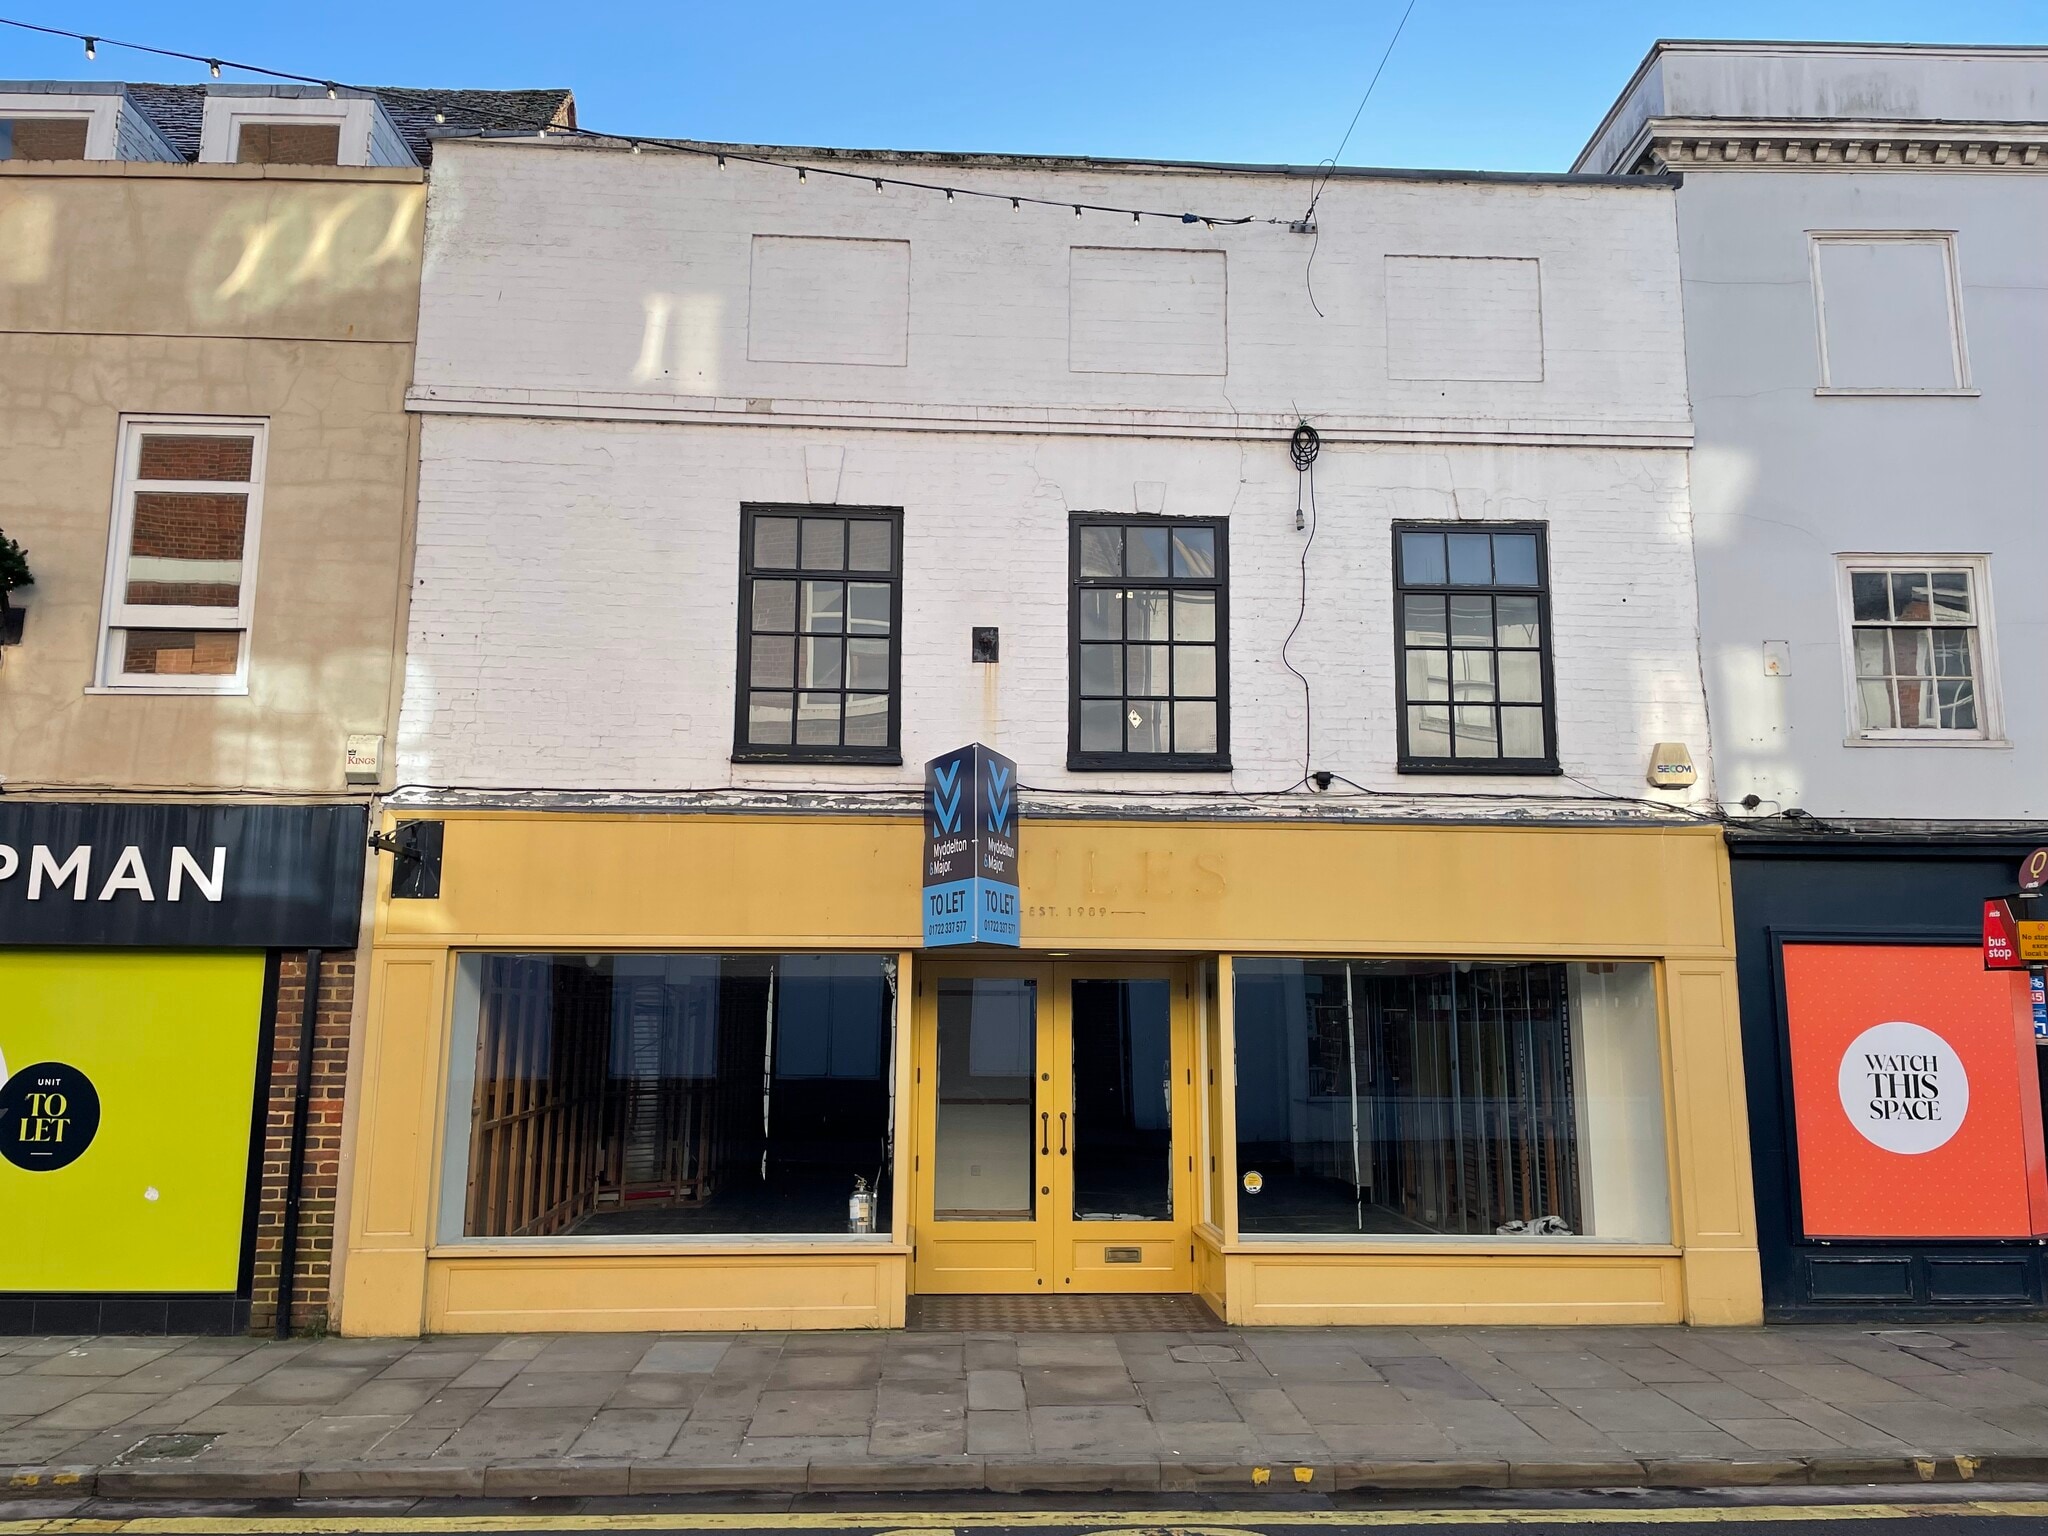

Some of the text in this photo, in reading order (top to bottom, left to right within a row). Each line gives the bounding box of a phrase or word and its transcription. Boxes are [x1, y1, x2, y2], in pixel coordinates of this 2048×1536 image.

[347, 756, 376, 765] KINGS
[1657, 765, 1691, 773] SECOM
[933, 839, 967, 859] Myddelton
[988, 837, 1015, 858] Myddelton
[930, 890, 966, 916] TO LET
[985, 890, 1014, 915] TO LET
[1029, 906, 1107, 917] EST. 1989
[1988, 936, 2007, 946] bus
[1988, 948, 2012, 960] stop
[1864, 1054, 1938, 1072] WATCH
[37, 1078, 61, 1086] UNIT
[1866, 1073, 1939, 1099] THIS
[25, 1093, 67, 1117] TO
[1869, 1099, 1942, 1121] SPACE
[18, 1118, 71, 1142] LET
